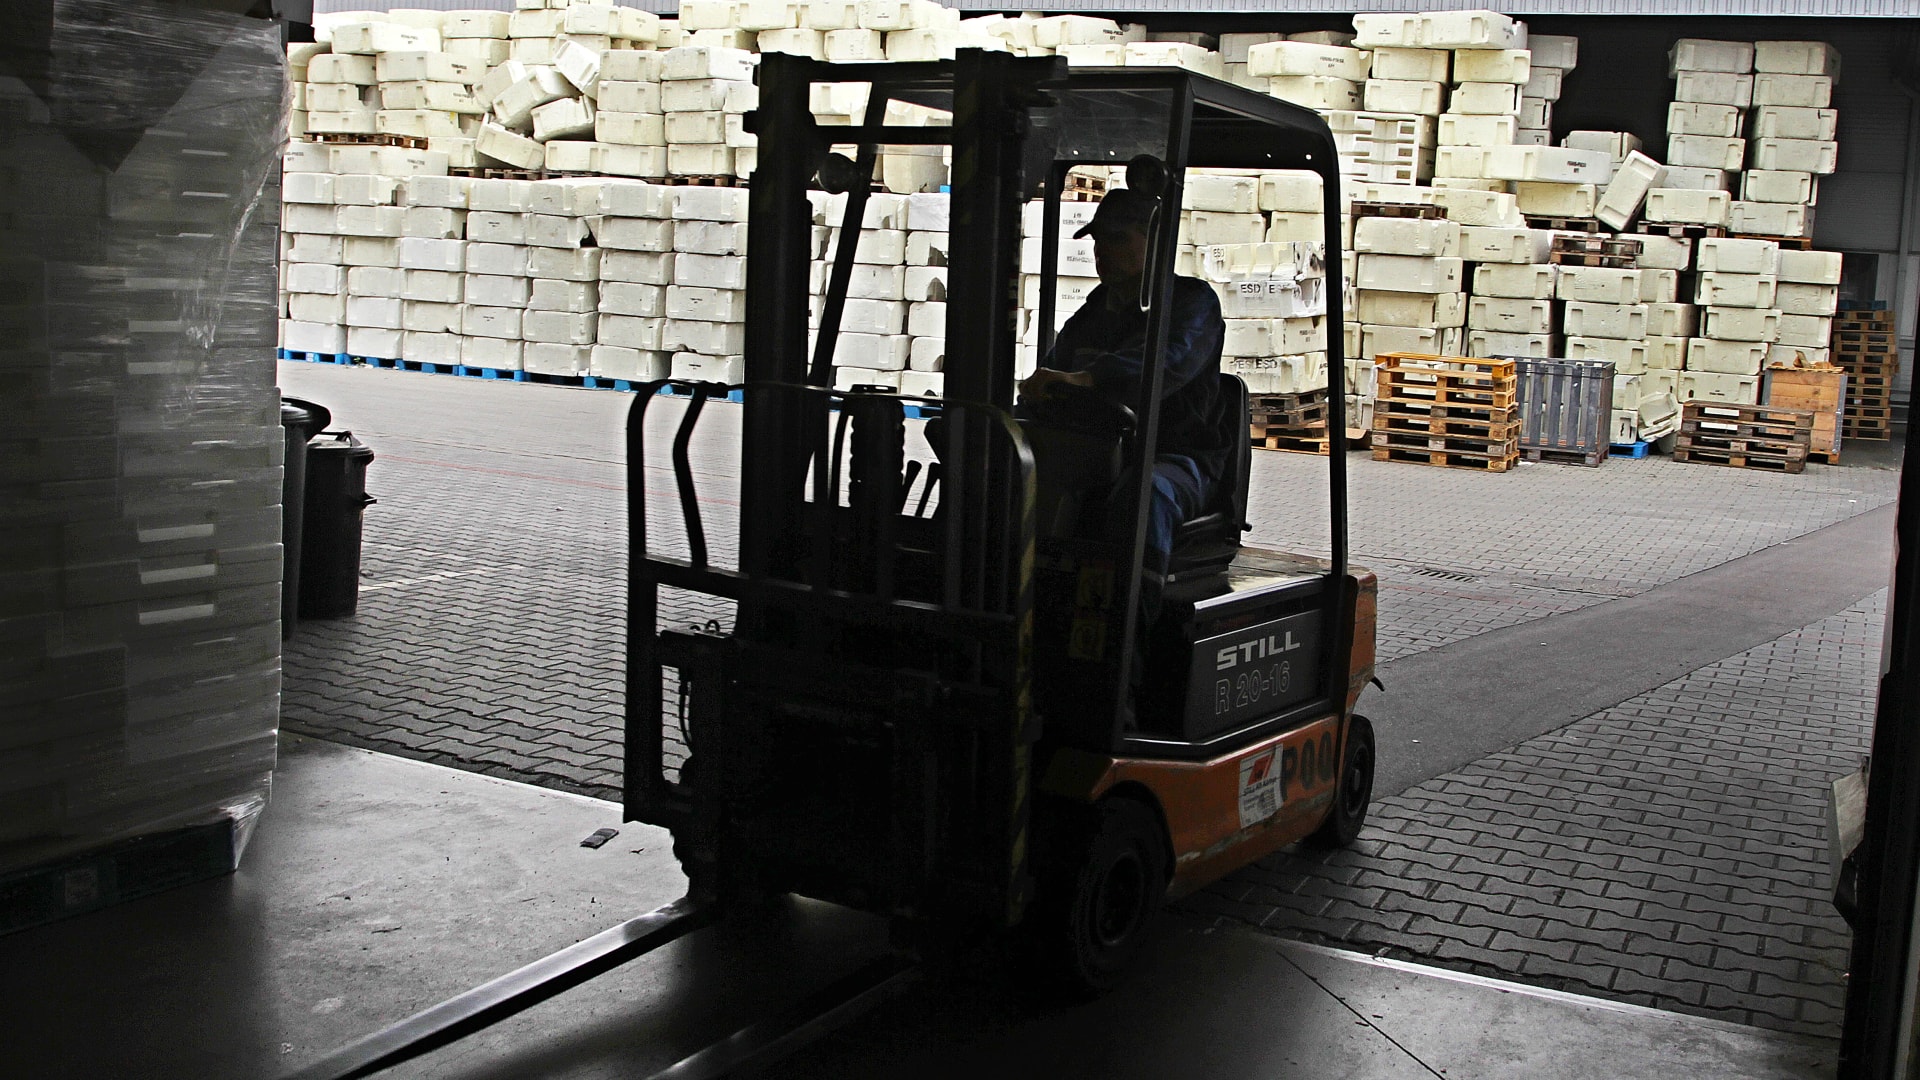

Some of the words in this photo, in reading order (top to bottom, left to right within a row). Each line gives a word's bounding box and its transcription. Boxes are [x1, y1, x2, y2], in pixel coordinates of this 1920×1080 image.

[1240, 283, 1261, 294] ESD
[1255, 358, 1278, 369] ESD
[1217, 631, 1301, 671] STILL
[1216, 678, 1231, 715] R
[1236, 660, 1291, 708] 20-16
